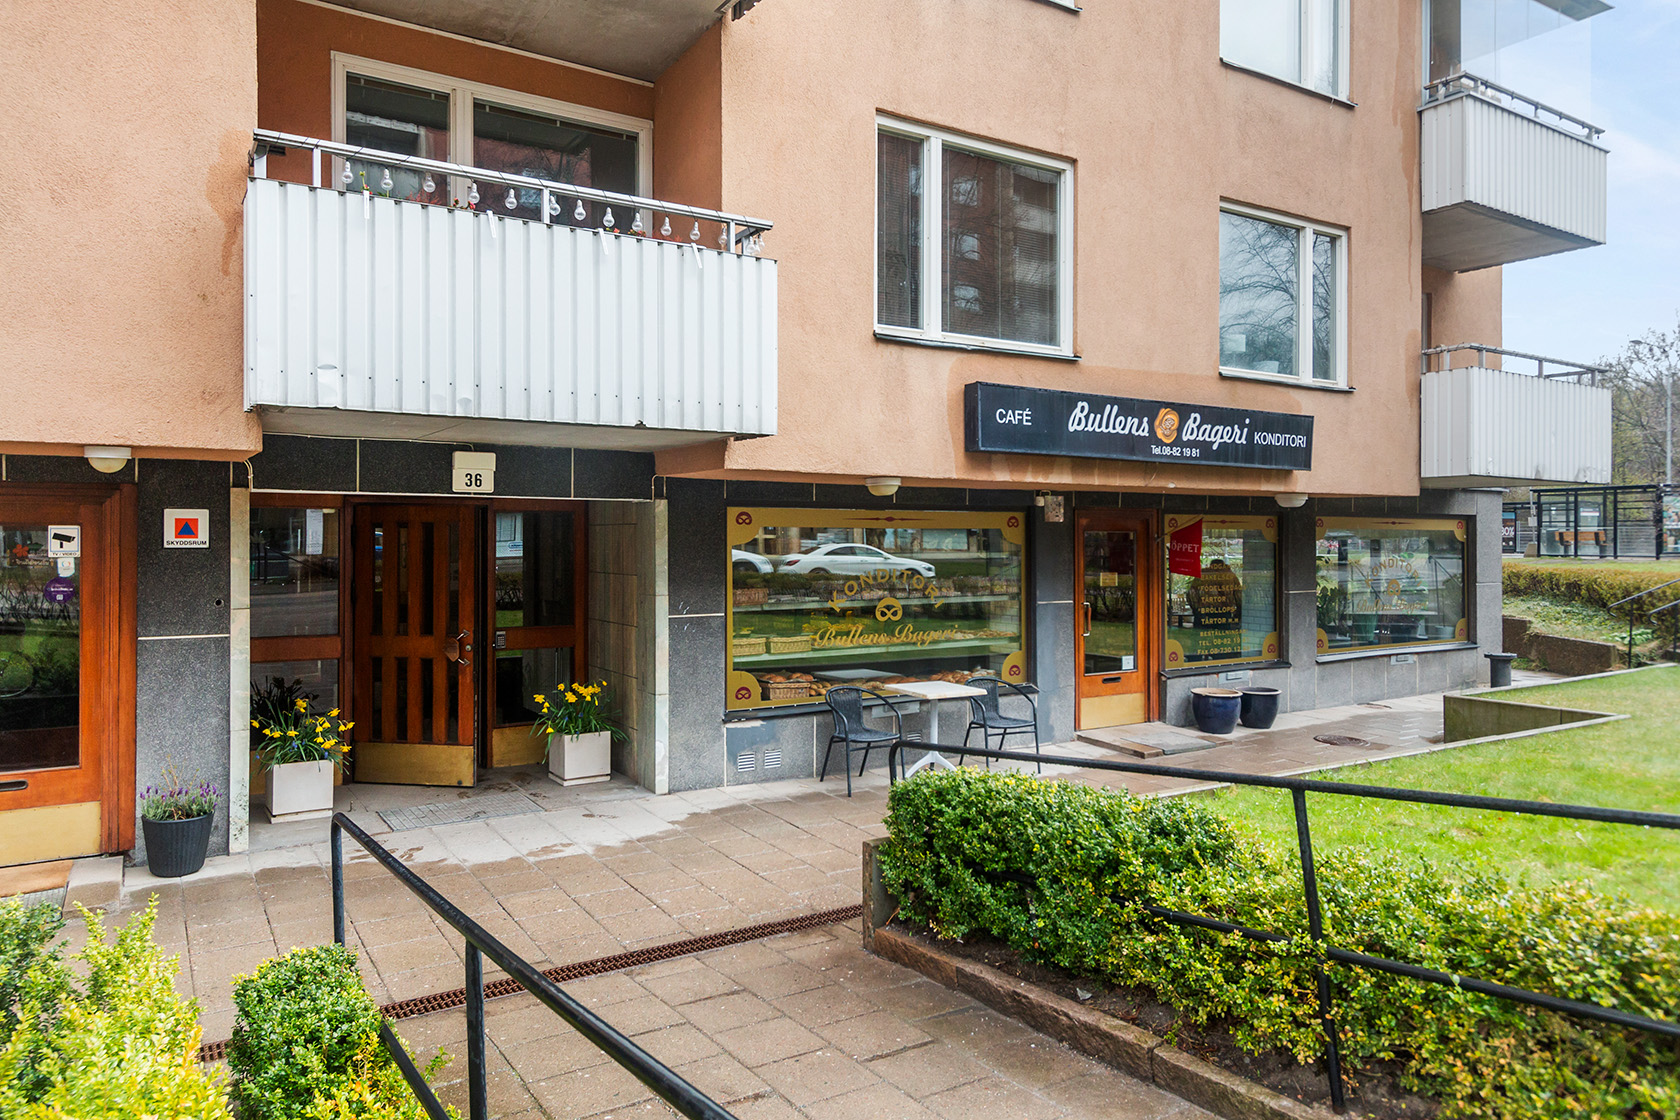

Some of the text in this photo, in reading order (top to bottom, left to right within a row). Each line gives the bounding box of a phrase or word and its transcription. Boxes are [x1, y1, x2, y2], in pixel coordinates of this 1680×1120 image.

[995, 408, 1032, 426] CAFÉ
[1068, 401, 1250, 450] Bullens Bageri
[1254, 432, 1307, 448] KONDITORI
[1183, 447, 1191, 457] 19
[1191, 448, 1200, 457] 81
[464, 472, 483, 488] 36
[1171, 541, 1199, 553] ÖPPET
[1364, 558, 1422, 588] KONDITORI
[827, 568, 944, 613] KONDITORI
[1201, 616, 1226, 625] TÅRTOR
[814, 623, 959, 648] Bullens Bageri
